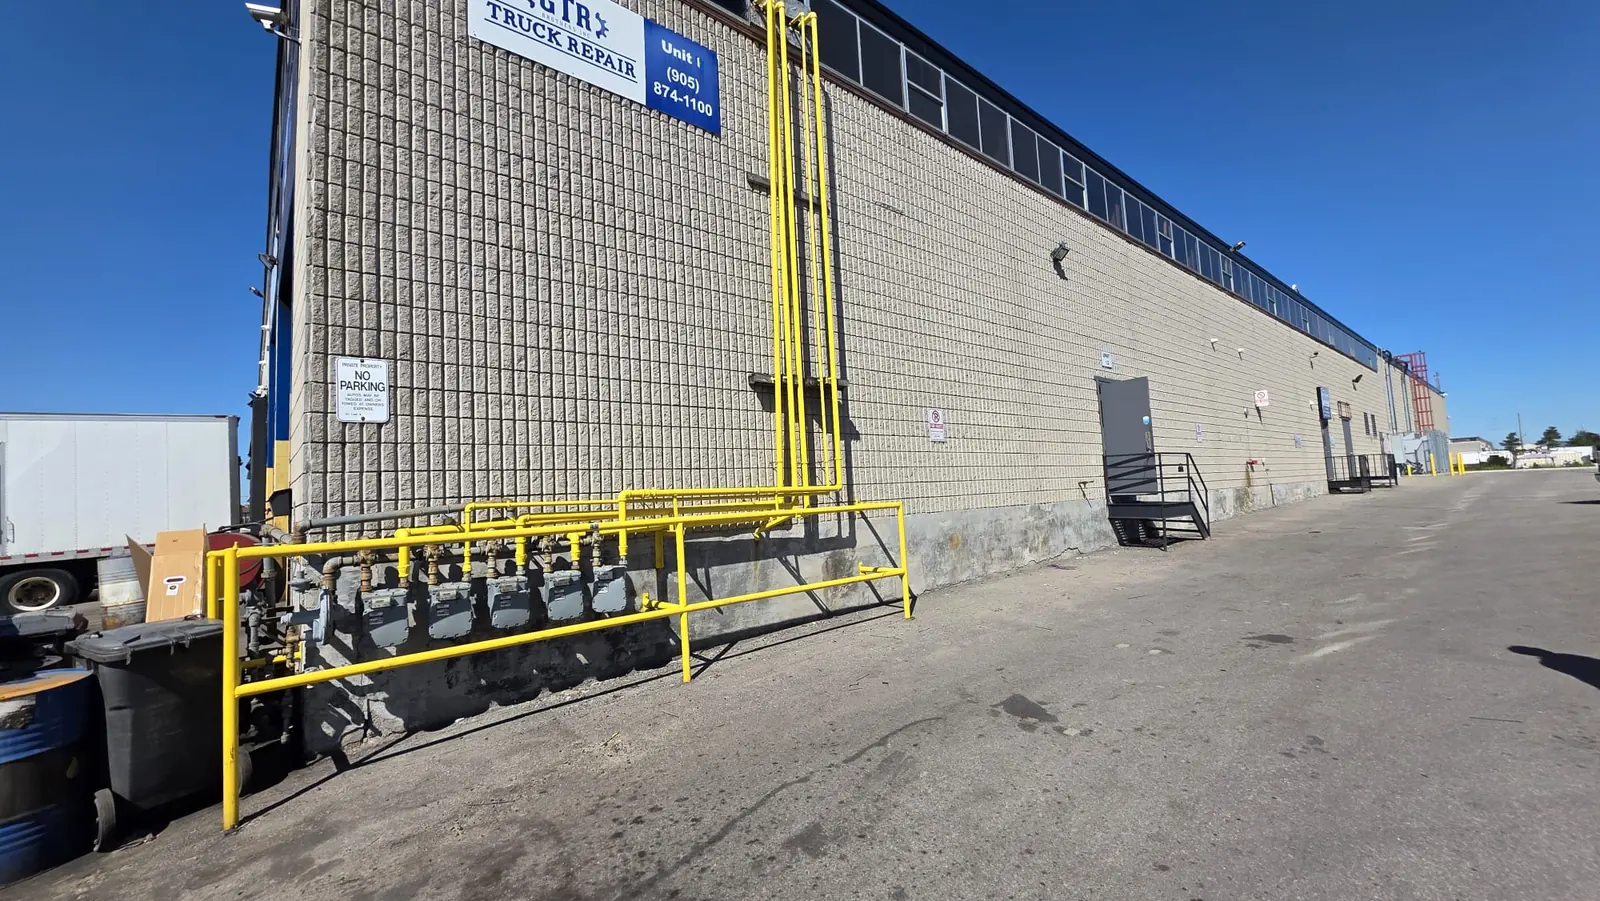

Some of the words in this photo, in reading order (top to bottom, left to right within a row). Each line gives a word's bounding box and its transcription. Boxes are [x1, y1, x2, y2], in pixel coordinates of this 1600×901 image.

[486, 1, 563, 47] TRUCK
[567, 35, 637, 79] REPAIR
[661, 39, 693, 65] Unit
[666, 66, 700, 95] (905)
[653, 80, 713, 117] 874-1100
[340, 380, 386, 392] PARKING
[355, 370, 371, 381] NO
